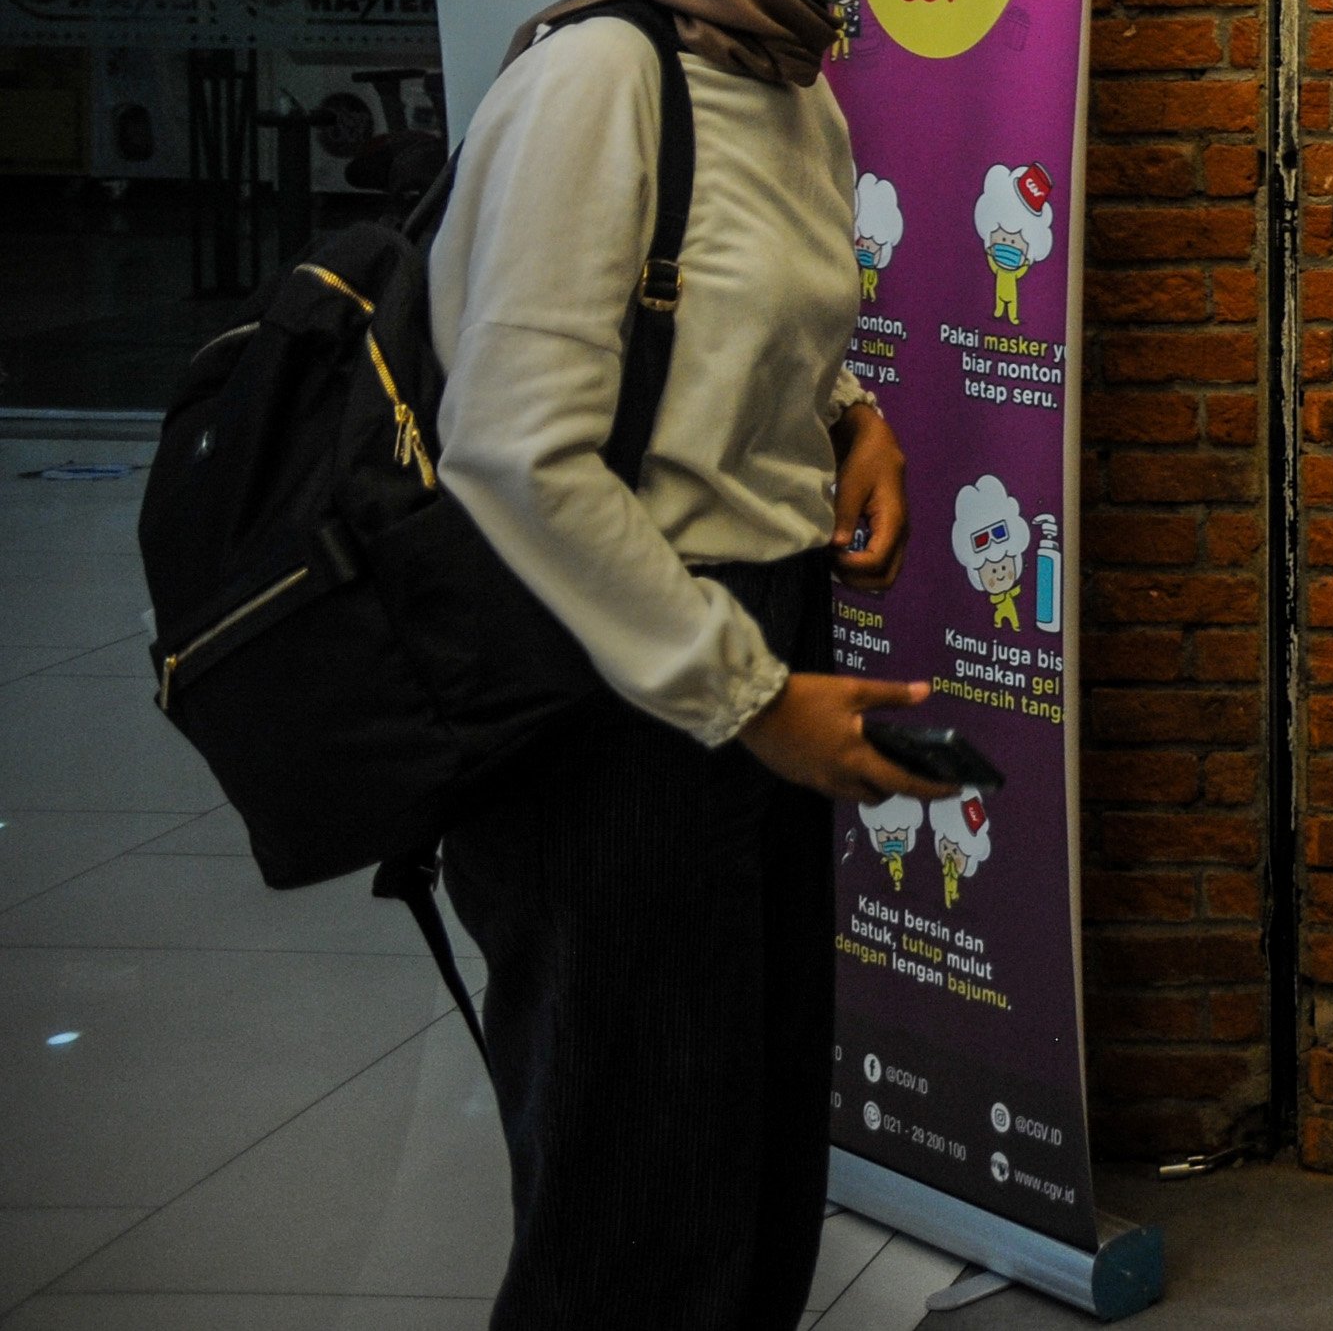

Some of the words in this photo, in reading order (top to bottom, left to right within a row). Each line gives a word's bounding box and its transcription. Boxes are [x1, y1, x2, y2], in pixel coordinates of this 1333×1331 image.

[862, 338, 894, 357] suhu
[940, 324, 979, 349] Pakai
[983, 334, 1048, 358] masker
[843, 359, 874, 378] amu
[878, 365, 900, 383] ya.
[962, 351, 992, 374] biar
[997, 360, 1062, 384] nonton
[965, 378, 1007, 404] tetap
[1012, 387, 1058, 408] seru.
[838, 600, 883, 629] tangan
[850, 629, 890, 655] sabun
[945, 628, 987, 656] Kamu
[992, 636, 1031, 666] juga
[846, 650, 866, 671] air.
[955, 657, 1026, 688] gunakan
[1032, 676, 1060, 695] gel
[933, 676, 1015, 710] pembersih
[1021, 695, 1065, 724] tang
[859, 895, 899, 925] Kalau
[904, 909, 950, 942] bersin
[954, 930, 984, 954] dan
[851, 914, 897, 950] batuk,
[902, 933, 942, 963] tutup
[947, 951, 993, 980] mulut
[835, 933, 887, 967] dengan
[892, 952, 943, 986] lengan
[947, 972, 1012, 1010] bajumu.
[886, 1065, 928, 1095] @CGV.ID
[883, 1114, 901, 1135] 021
[912, 1126, 925, 1145] 29
[926, 1130, 945, 1153] 200
[947, 1140, 967, 1161] 100
[1015, 1114, 1062, 1147] @CGV.ID
[1014, 1169, 1075, 1204] www.cgv.id
